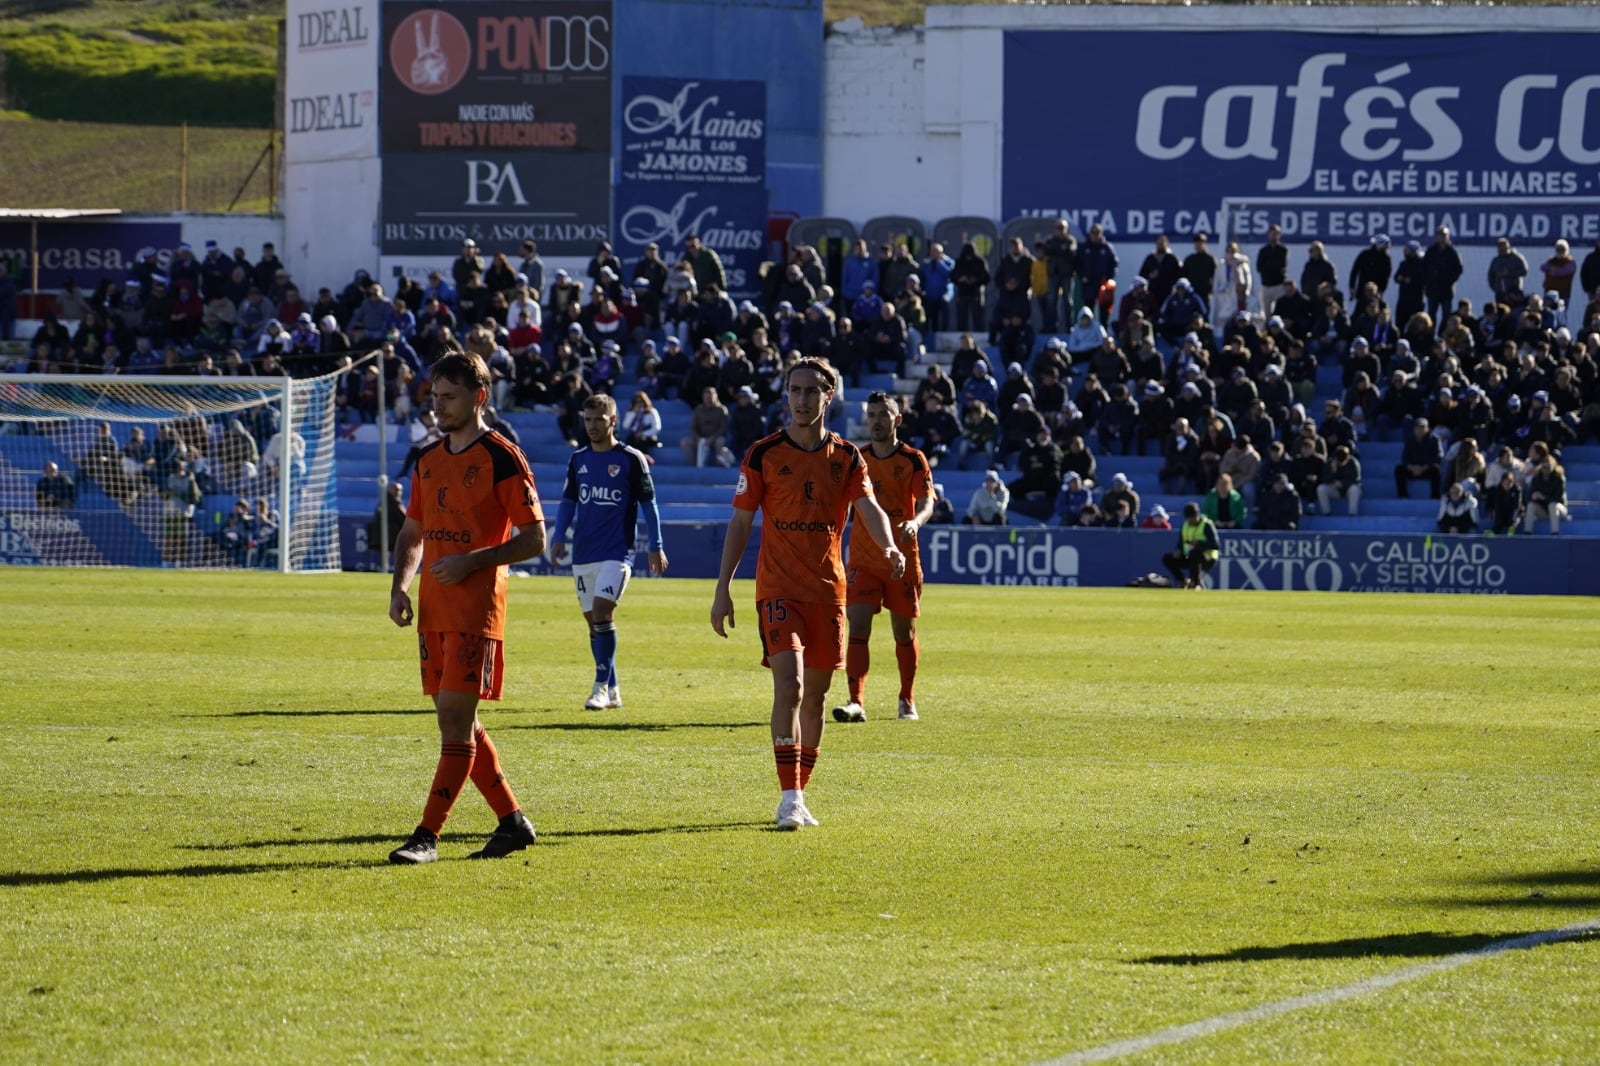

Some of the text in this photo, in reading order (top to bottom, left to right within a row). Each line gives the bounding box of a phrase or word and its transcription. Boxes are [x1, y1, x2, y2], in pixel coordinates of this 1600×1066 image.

[298, 6, 368, 48] IDEAL
[477, 15, 609, 71] PONDOS
[289, 92, 363, 134] IDEAL
[458, 101, 535, 121] NADIE CON MÁS
[624, 82, 763, 139] Mañas
[1135, 53, 1463, 190] cafés
[418, 122, 577, 147] TAPAS Y RACIONES
[665, 137, 702, 152] BAR
[710, 140, 737, 152] LOS
[638, 153, 748, 173] JAMONES
[1314, 164, 1577, 194] EL CAFÉ DE LINARES
[385, 223, 466, 241] BUSTOS
[488, 223, 609, 242] ASOCIADOS
[1127, 210, 1164, 234] DE
[1280, 211, 1318, 235] DE
[1329, 211, 1550, 238] ESPECIALIDAD
[591, 486, 622, 502] MLC
[929, 529, 1079, 575] florida
[1220, 535, 1339, 559] RNICERÍA
[1367, 541, 1490, 564] CALIDAD
[577, 576, 586, 593] 4
[981, 575, 1079, 587] LINARES
[1351, 562, 1505, 587] Y SERVICIO
[765, 598, 787, 624] 15
